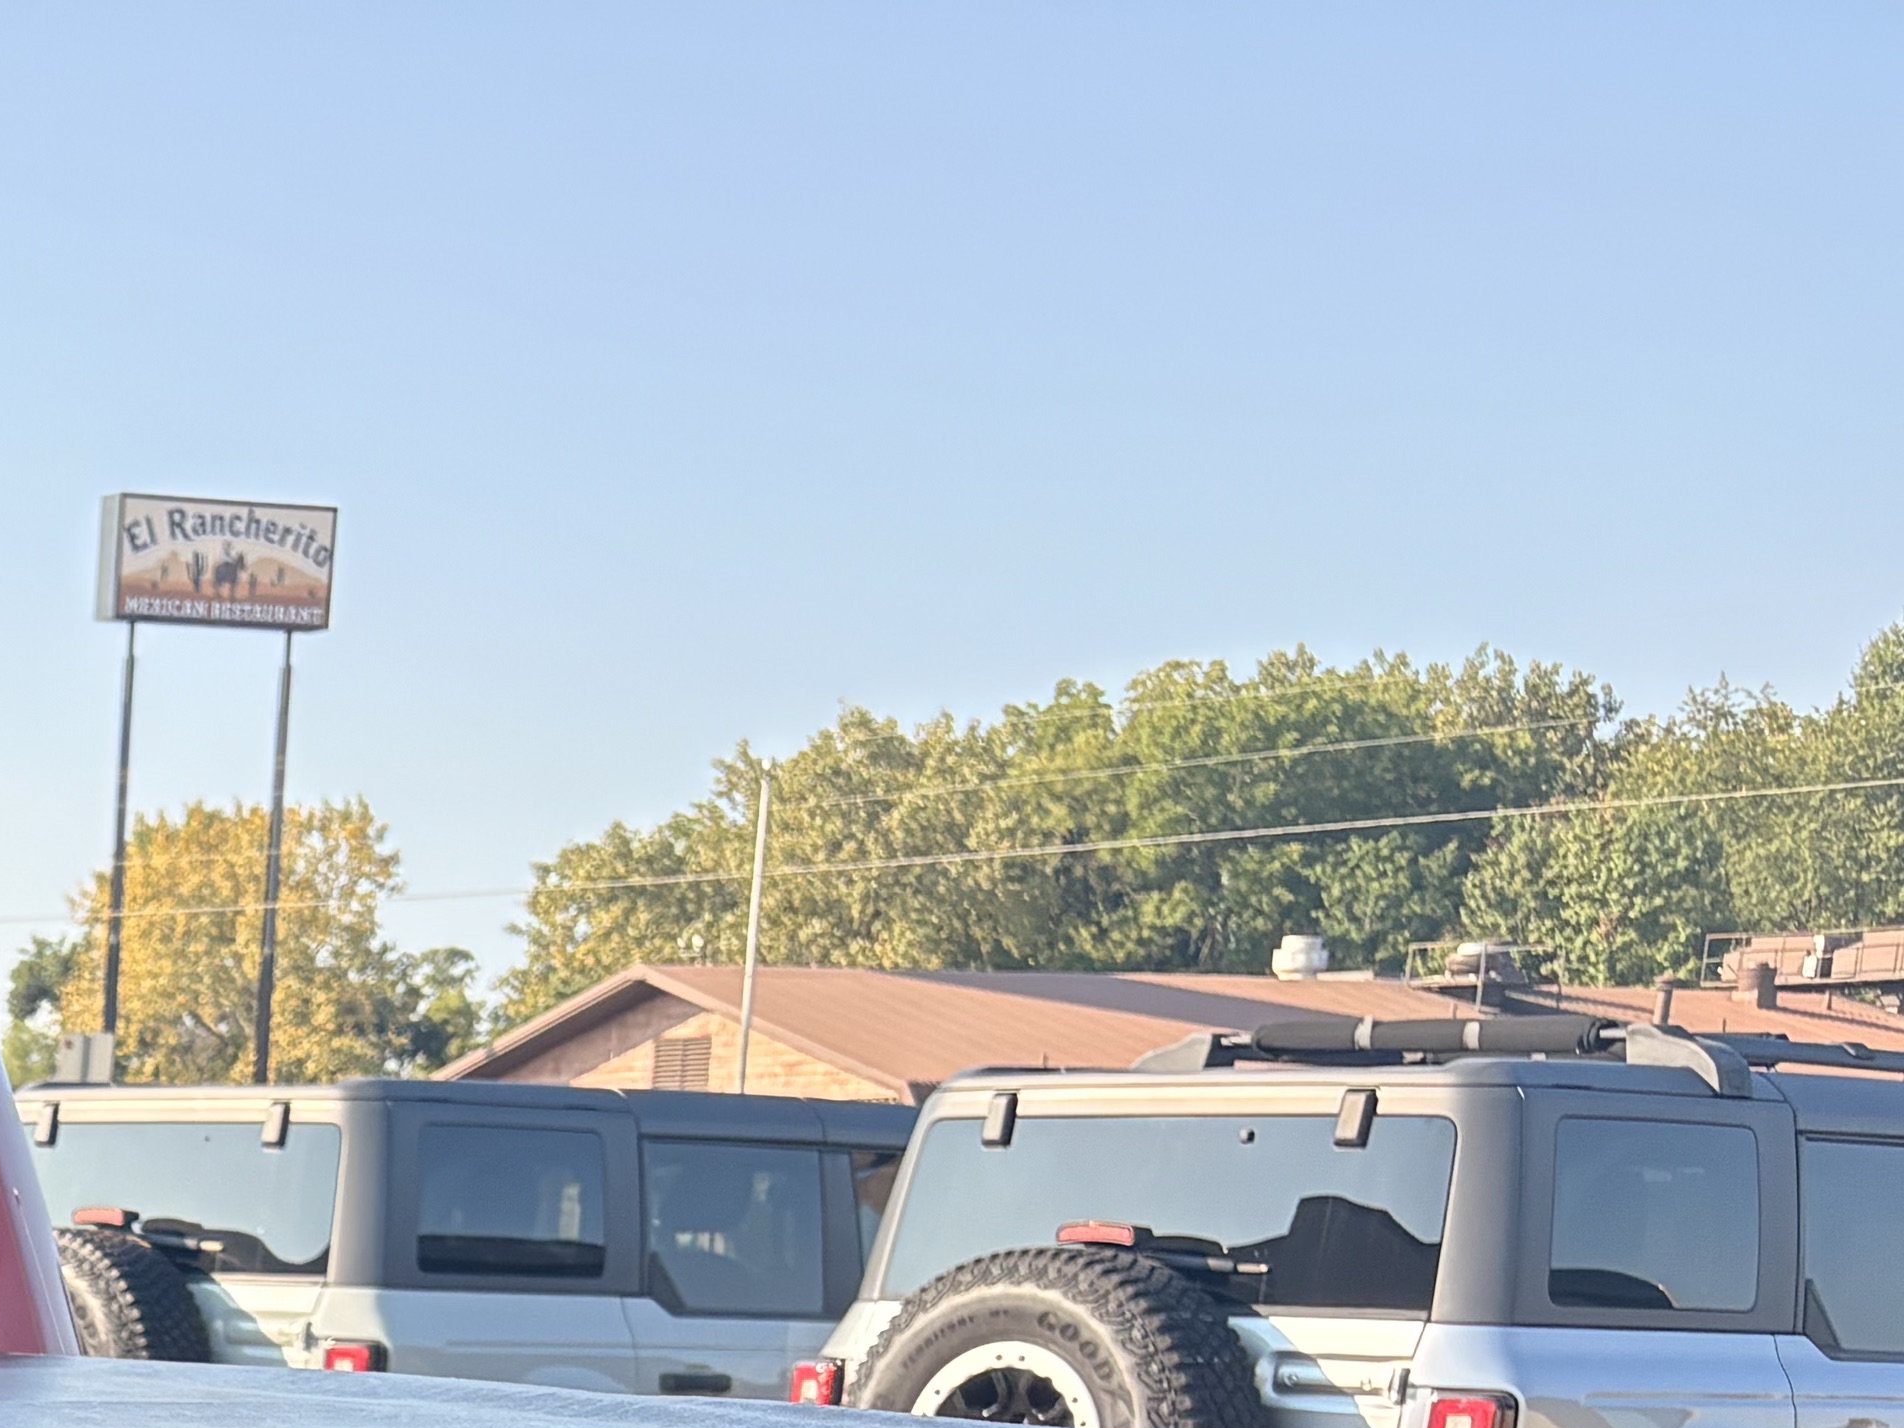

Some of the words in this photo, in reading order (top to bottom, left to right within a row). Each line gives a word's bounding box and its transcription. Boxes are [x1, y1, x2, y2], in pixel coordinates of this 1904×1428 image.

[126, 514, 158, 554] El
[167, 507, 333, 569] Rancherito
[124, 596, 207, 619] MEXICAN
